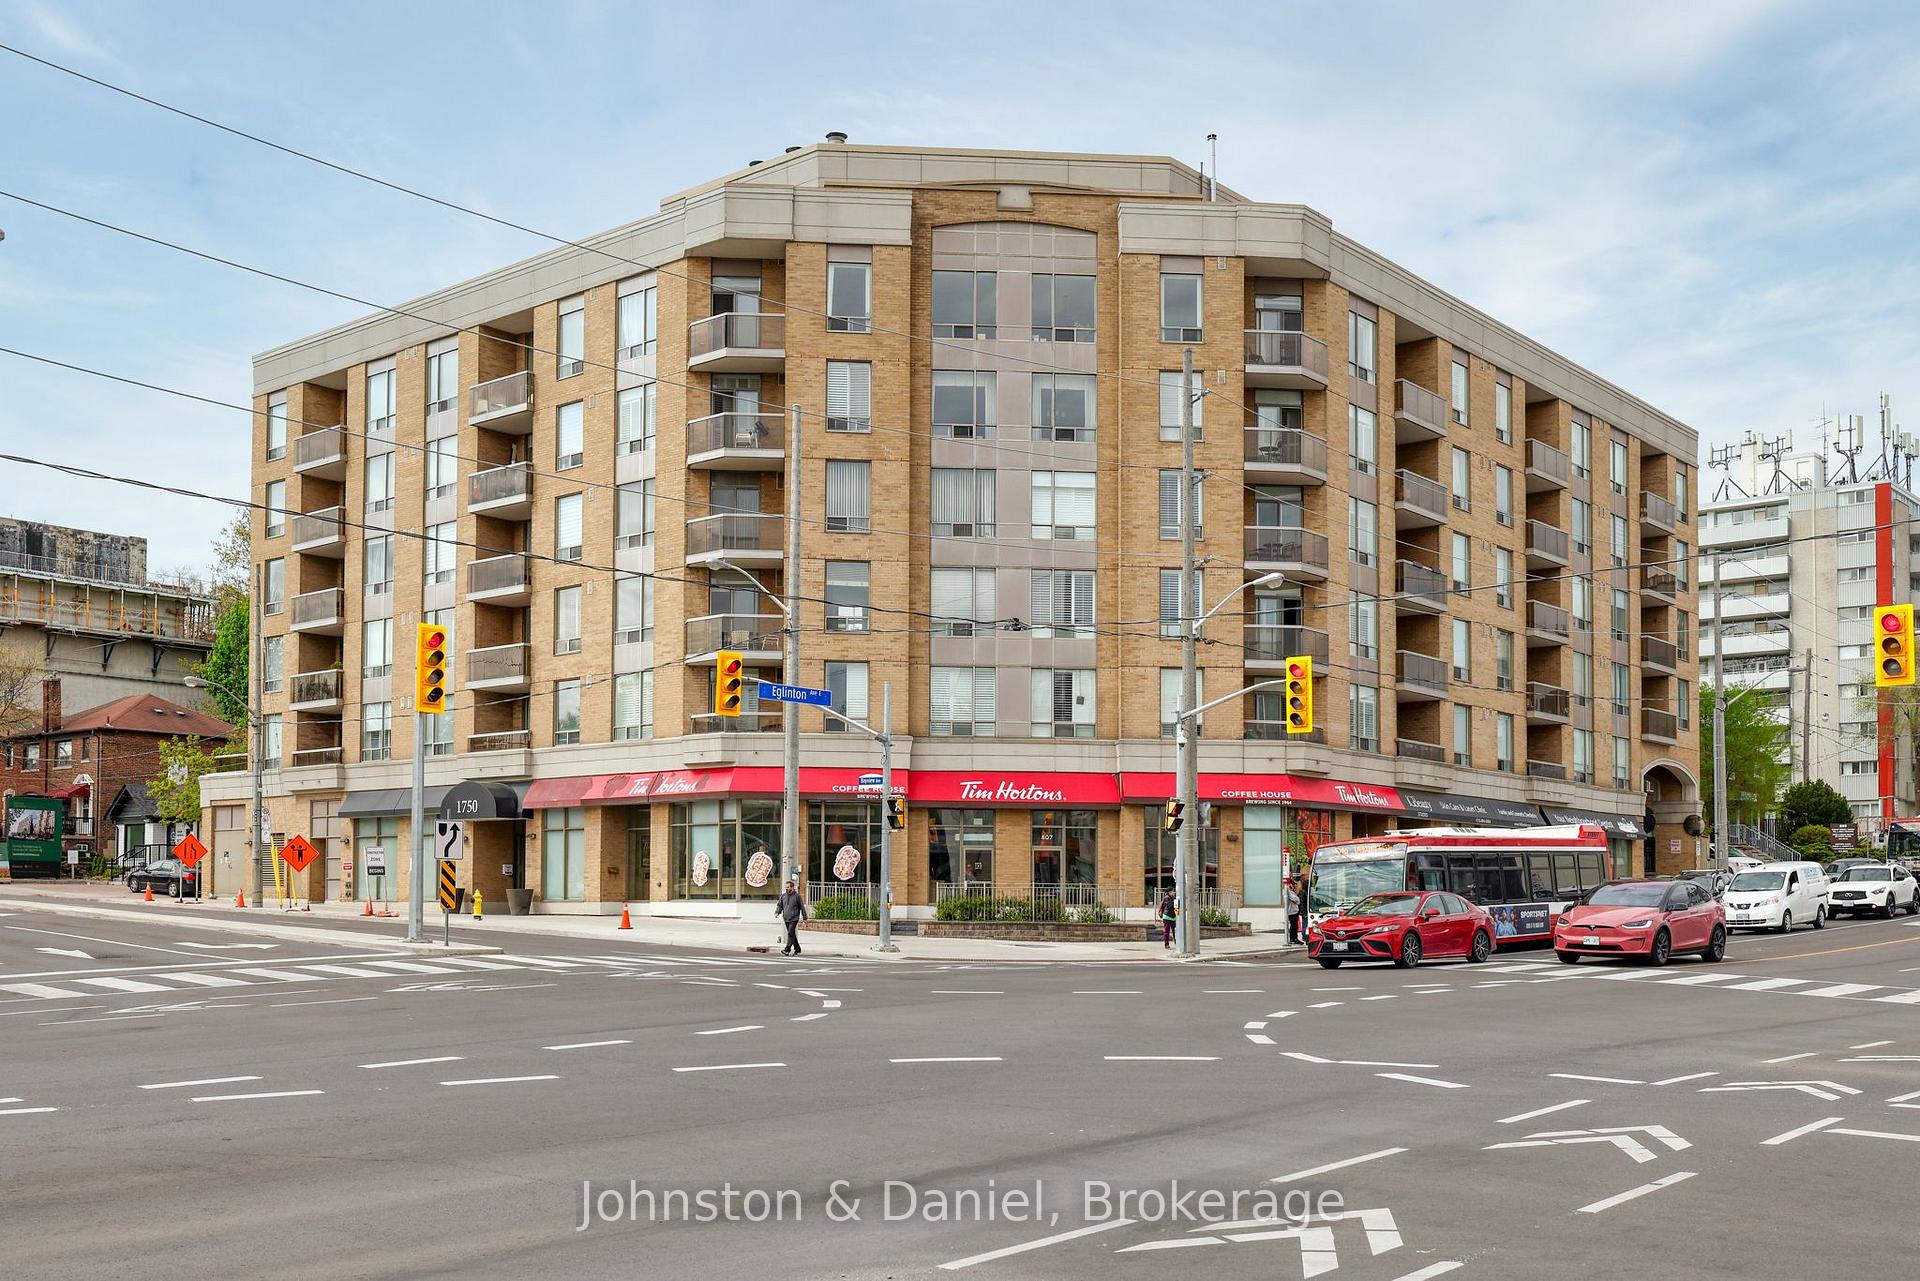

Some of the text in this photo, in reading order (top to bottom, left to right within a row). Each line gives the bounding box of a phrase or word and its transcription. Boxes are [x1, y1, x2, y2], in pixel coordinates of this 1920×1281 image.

[772, 686, 807, 700] Eglinton
[628, 778, 650, 795] Tim
[960, 780, 1063, 801] Tim Hortons
[1221, 790, 1258, 798] COFFEE
[1334, 785, 1390, 807] Tim Hortons
[456, 799, 478, 813] 1750
